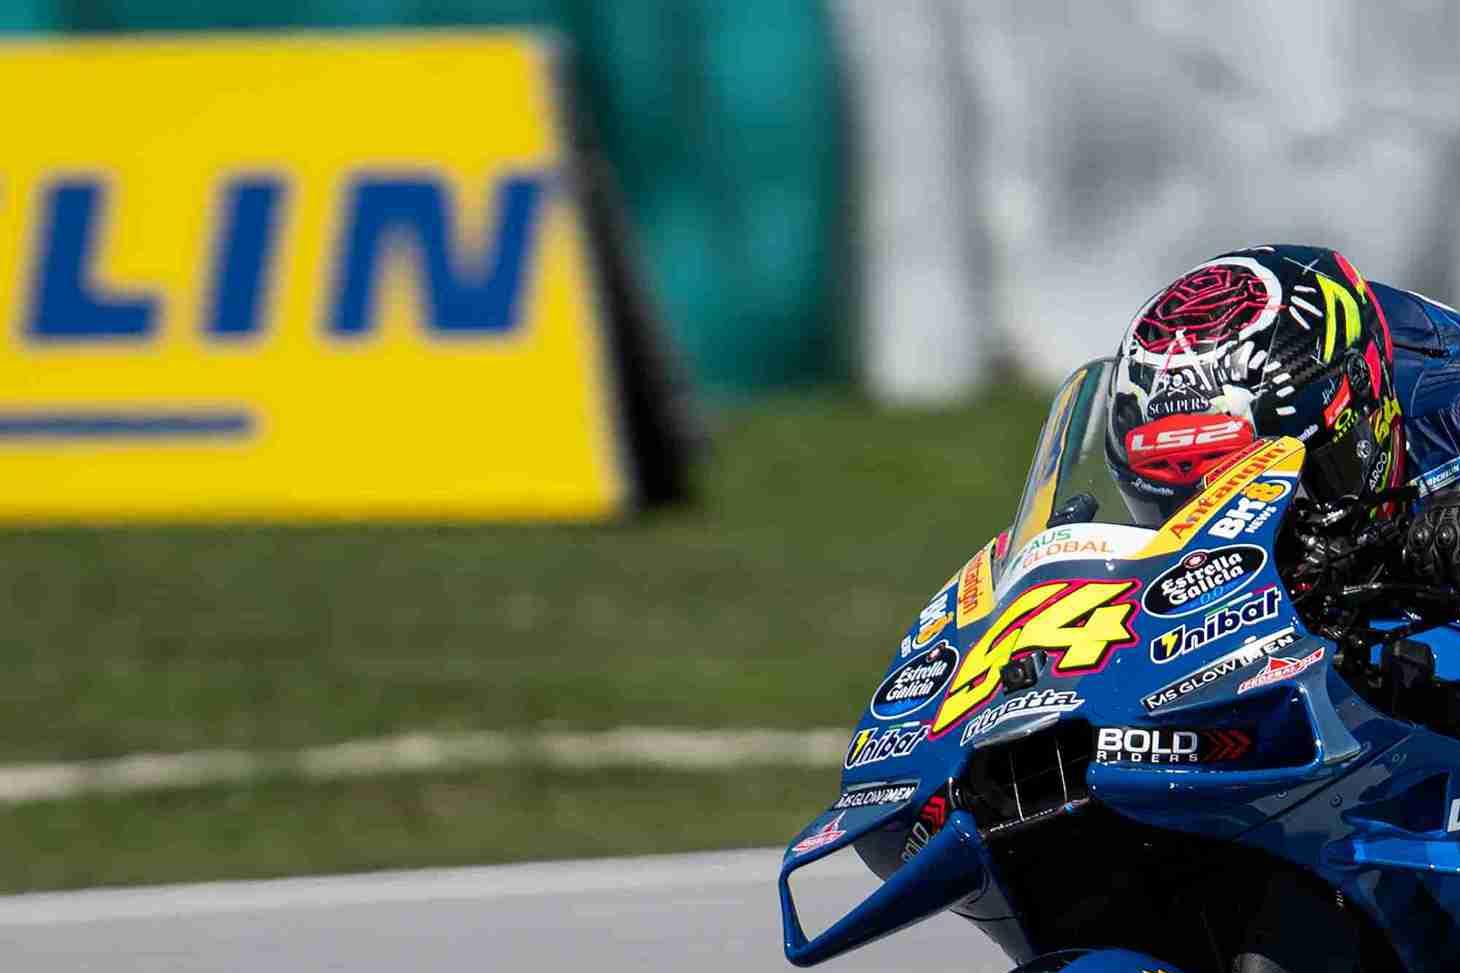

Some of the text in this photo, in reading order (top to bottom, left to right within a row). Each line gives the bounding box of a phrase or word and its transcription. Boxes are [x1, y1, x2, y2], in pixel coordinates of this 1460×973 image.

[1131, 421, 1244, 451] LS2
[1161, 552, 1243, 594] Estrella
[1169, 565, 1245, 605] Galicia
[1151, 586, 1282, 664] Unibat
[929, 579, 1143, 740] 54
[1180, 658, 1236, 695] GLOW
[1095, 750, 1199, 764] RIDERS
[1096, 727, 1199, 753] BOLD
